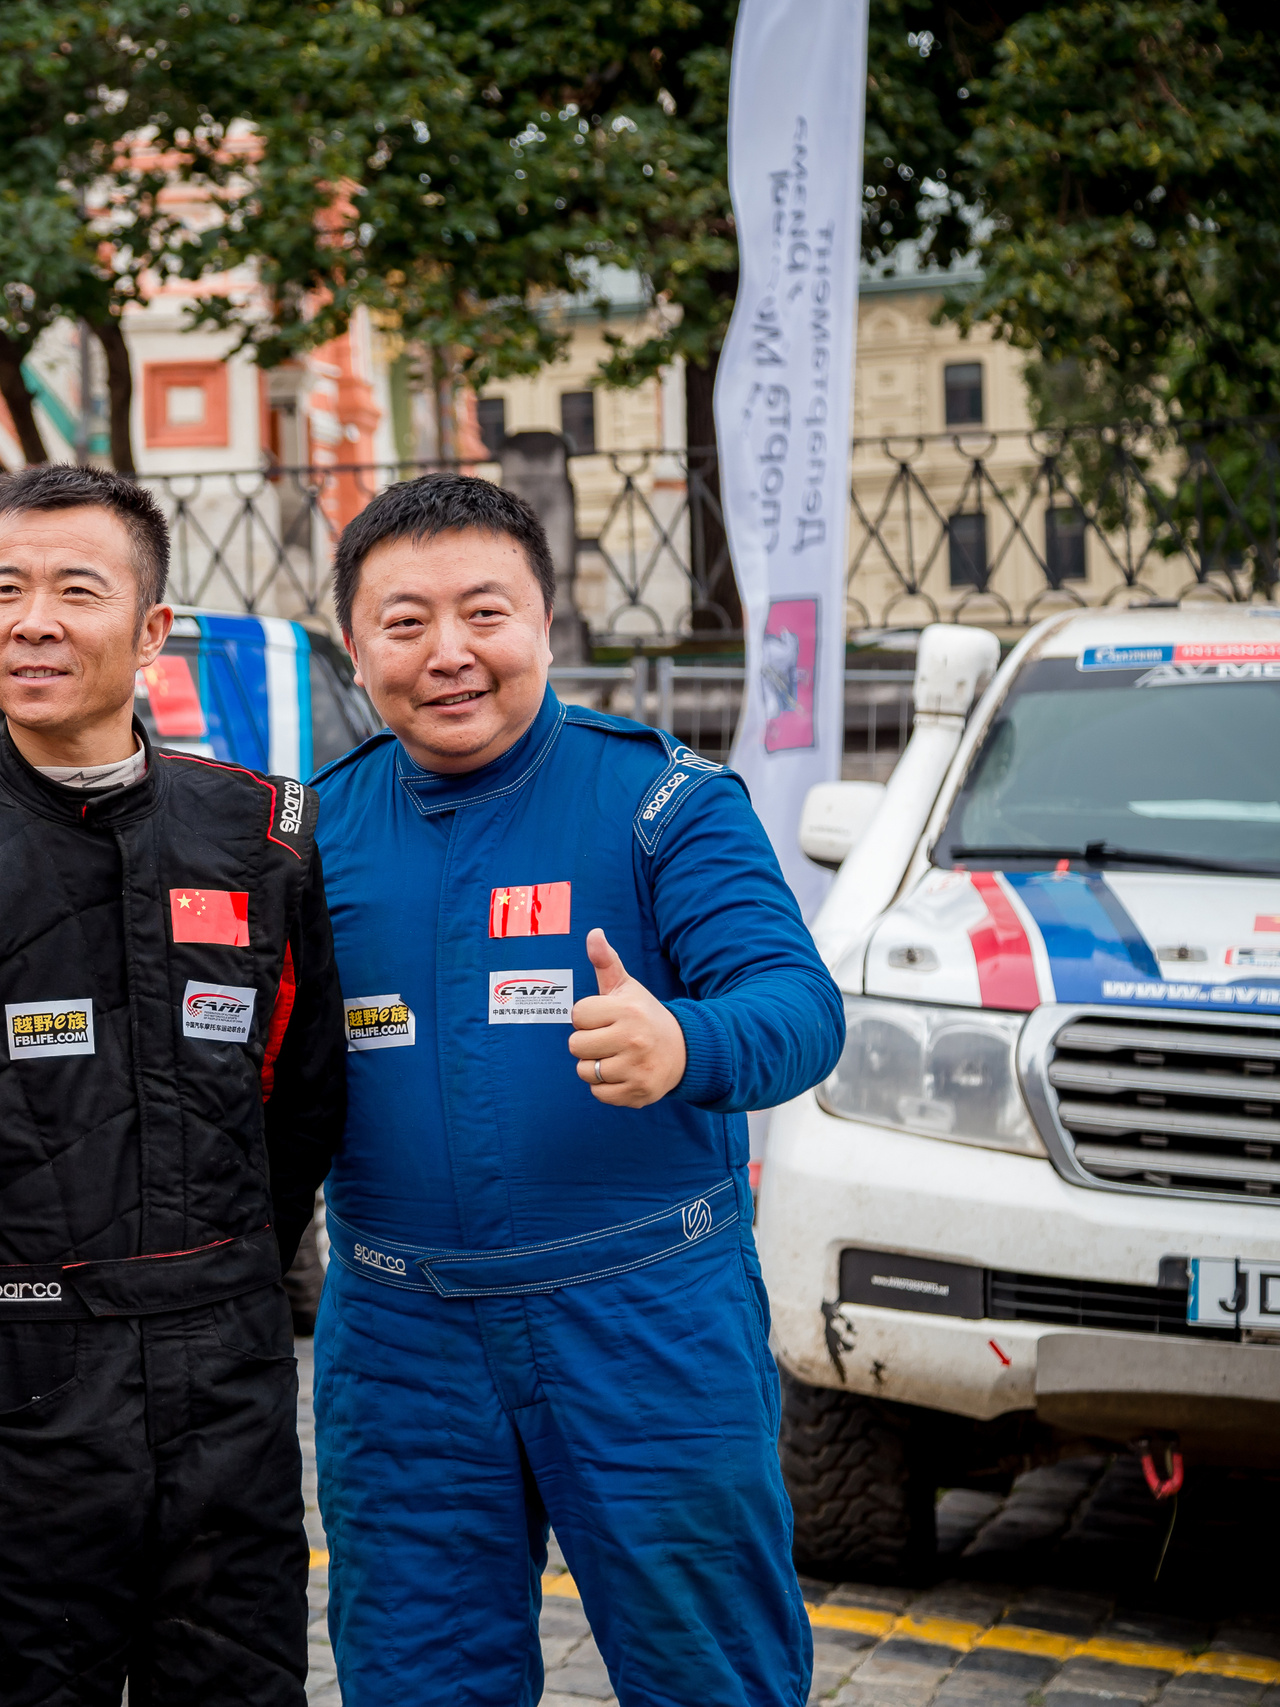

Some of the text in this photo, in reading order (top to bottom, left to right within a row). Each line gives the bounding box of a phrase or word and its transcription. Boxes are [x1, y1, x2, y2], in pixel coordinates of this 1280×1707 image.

[642, 772, 689, 821] sparco
[279, 781, 304, 834] sparco
[501, 985, 568, 995] CAMF
[192, 999, 250, 1013] CAMF
[348, 1006, 409, 1027] 越野e族
[13, 1011, 87, 1034] 越野e族
[350, 1023, 408, 1039] FBLIFE.COM
[15, 1031, 87, 1046] FBLIFE.COM
[353, 1243, 407, 1276] sparco
